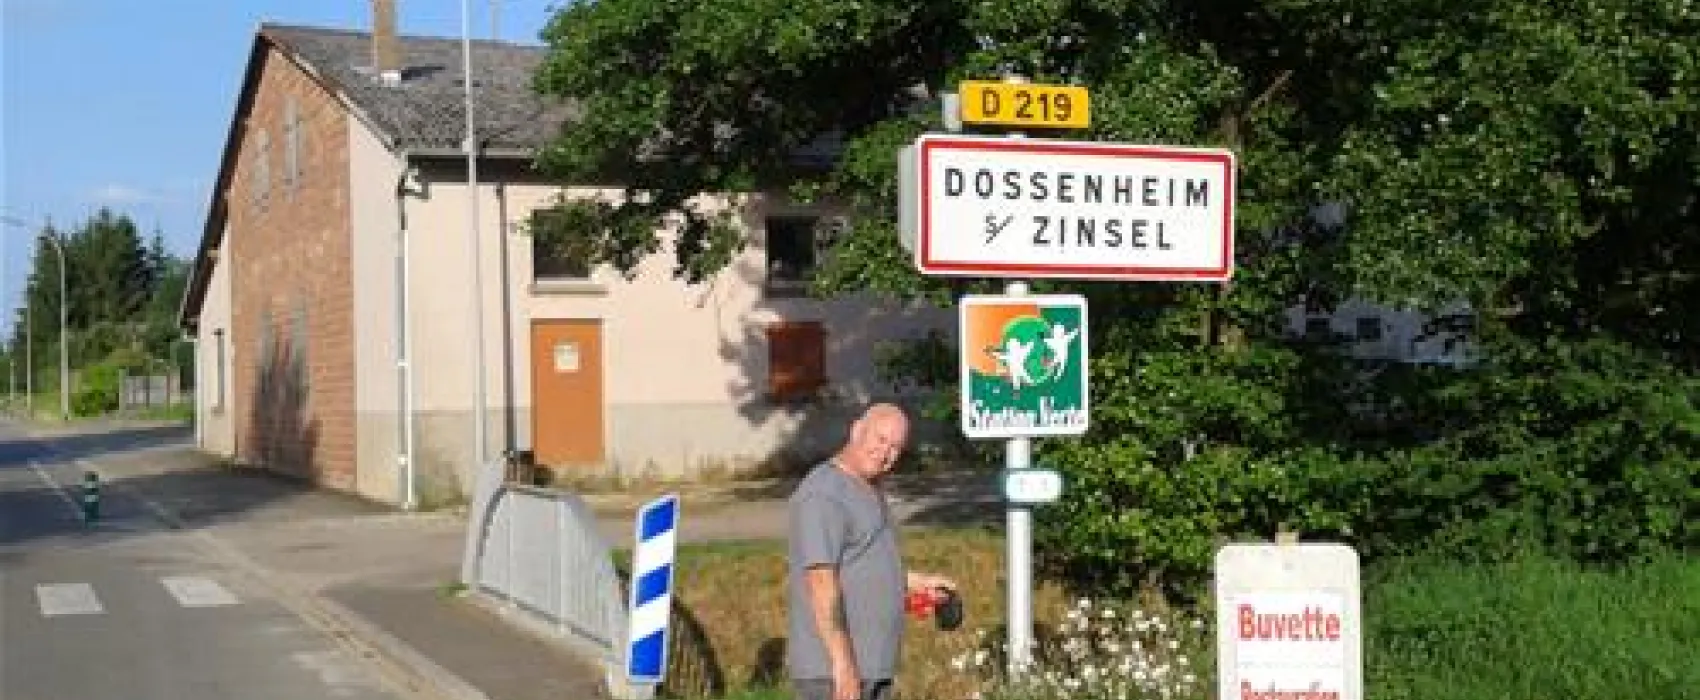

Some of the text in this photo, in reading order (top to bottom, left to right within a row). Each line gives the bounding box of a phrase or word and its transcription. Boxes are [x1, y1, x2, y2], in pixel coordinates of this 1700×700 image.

[981, 87, 1073, 122] D 219
[944, 168, 1210, 208] DOSSENHEIM
[1032, 215, 1173, 250] ZINSEL
[1238, 603, 1341, 641] Buvette
